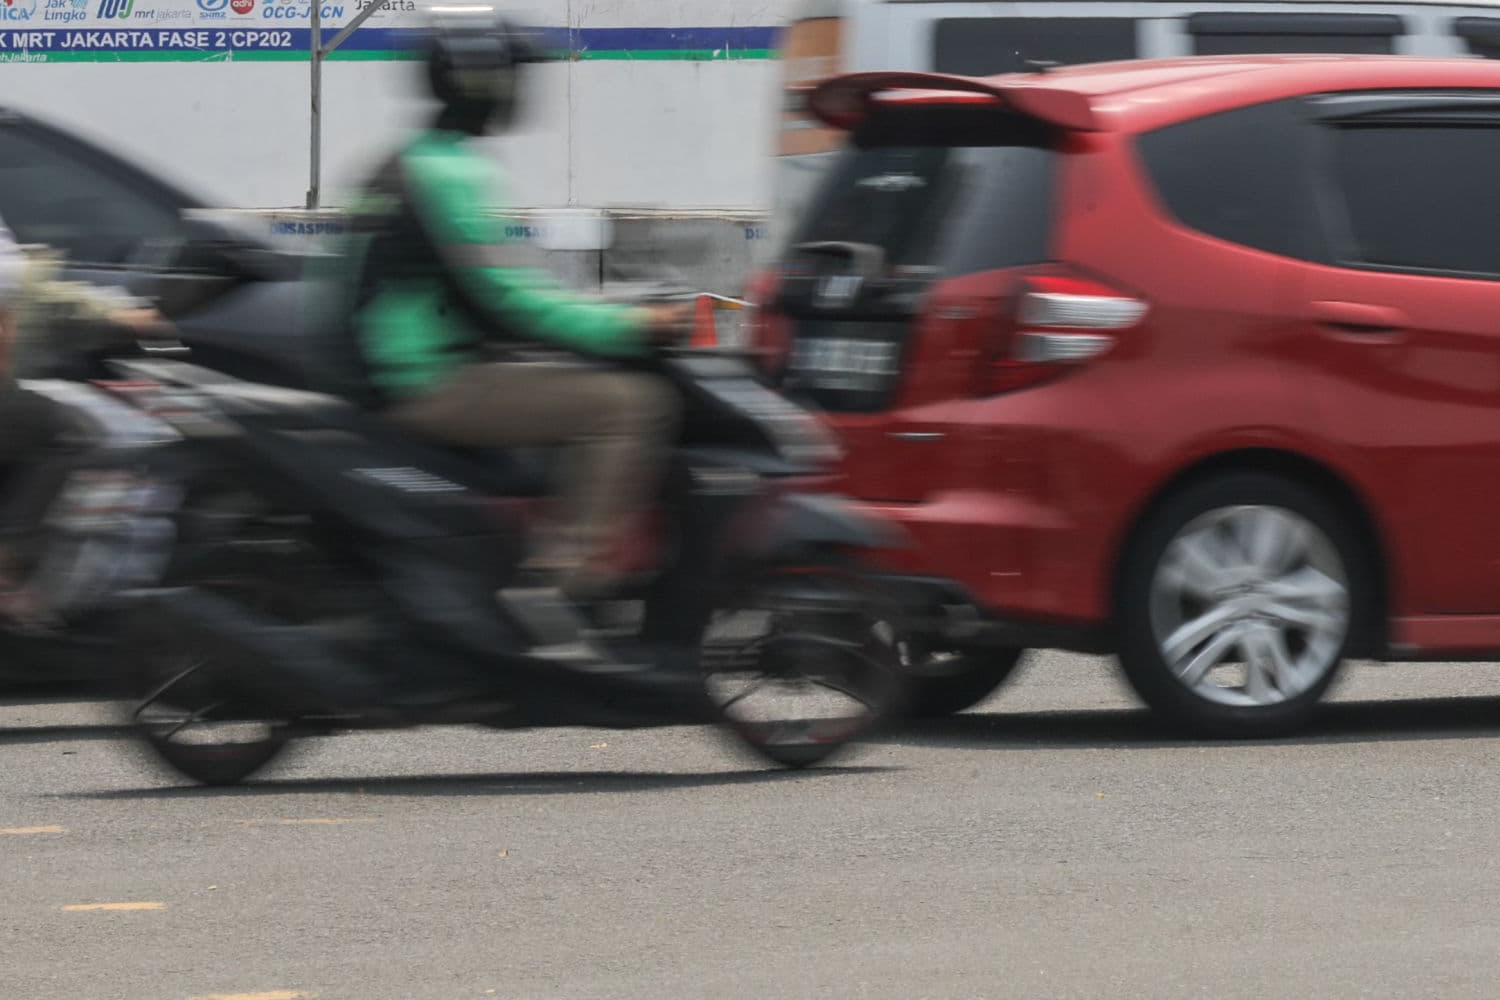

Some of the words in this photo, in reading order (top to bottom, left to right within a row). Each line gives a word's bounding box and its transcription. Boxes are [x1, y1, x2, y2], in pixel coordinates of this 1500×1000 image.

[44, 9, 87, 23] Lingko
[134, 9, 155, 19] mrt
[263, 6, 344, 19] OCG-JCN
[13, 32, 56, 48] MRT
[61, 32, 154, 48] JAKARTA
[159, 31, 209, 47] FASE
[215, 31, 225, 47] 2
[232, 31, 292, 47] CP202
